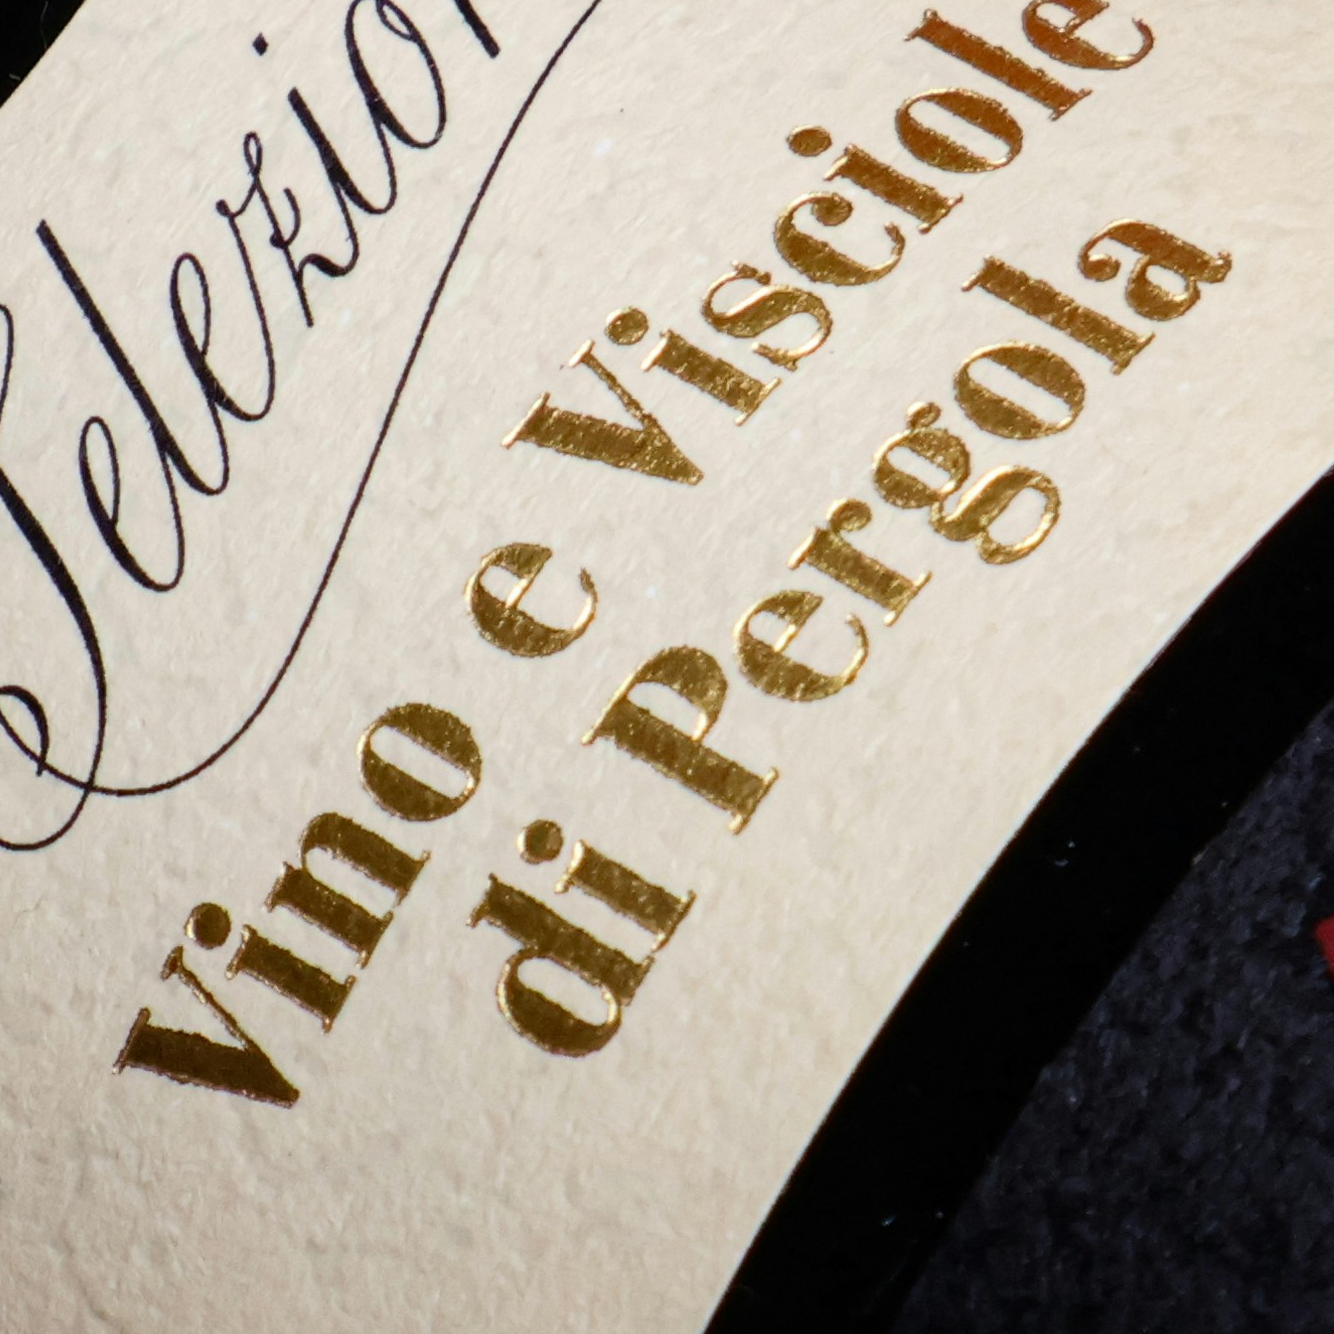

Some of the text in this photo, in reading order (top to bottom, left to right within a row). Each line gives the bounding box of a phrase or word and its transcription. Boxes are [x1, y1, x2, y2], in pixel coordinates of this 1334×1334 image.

[113, 701, 483, 1110] Vino
[465, 539, 600, 659] e
[469, 217, 1234, 1060] di Pergola
